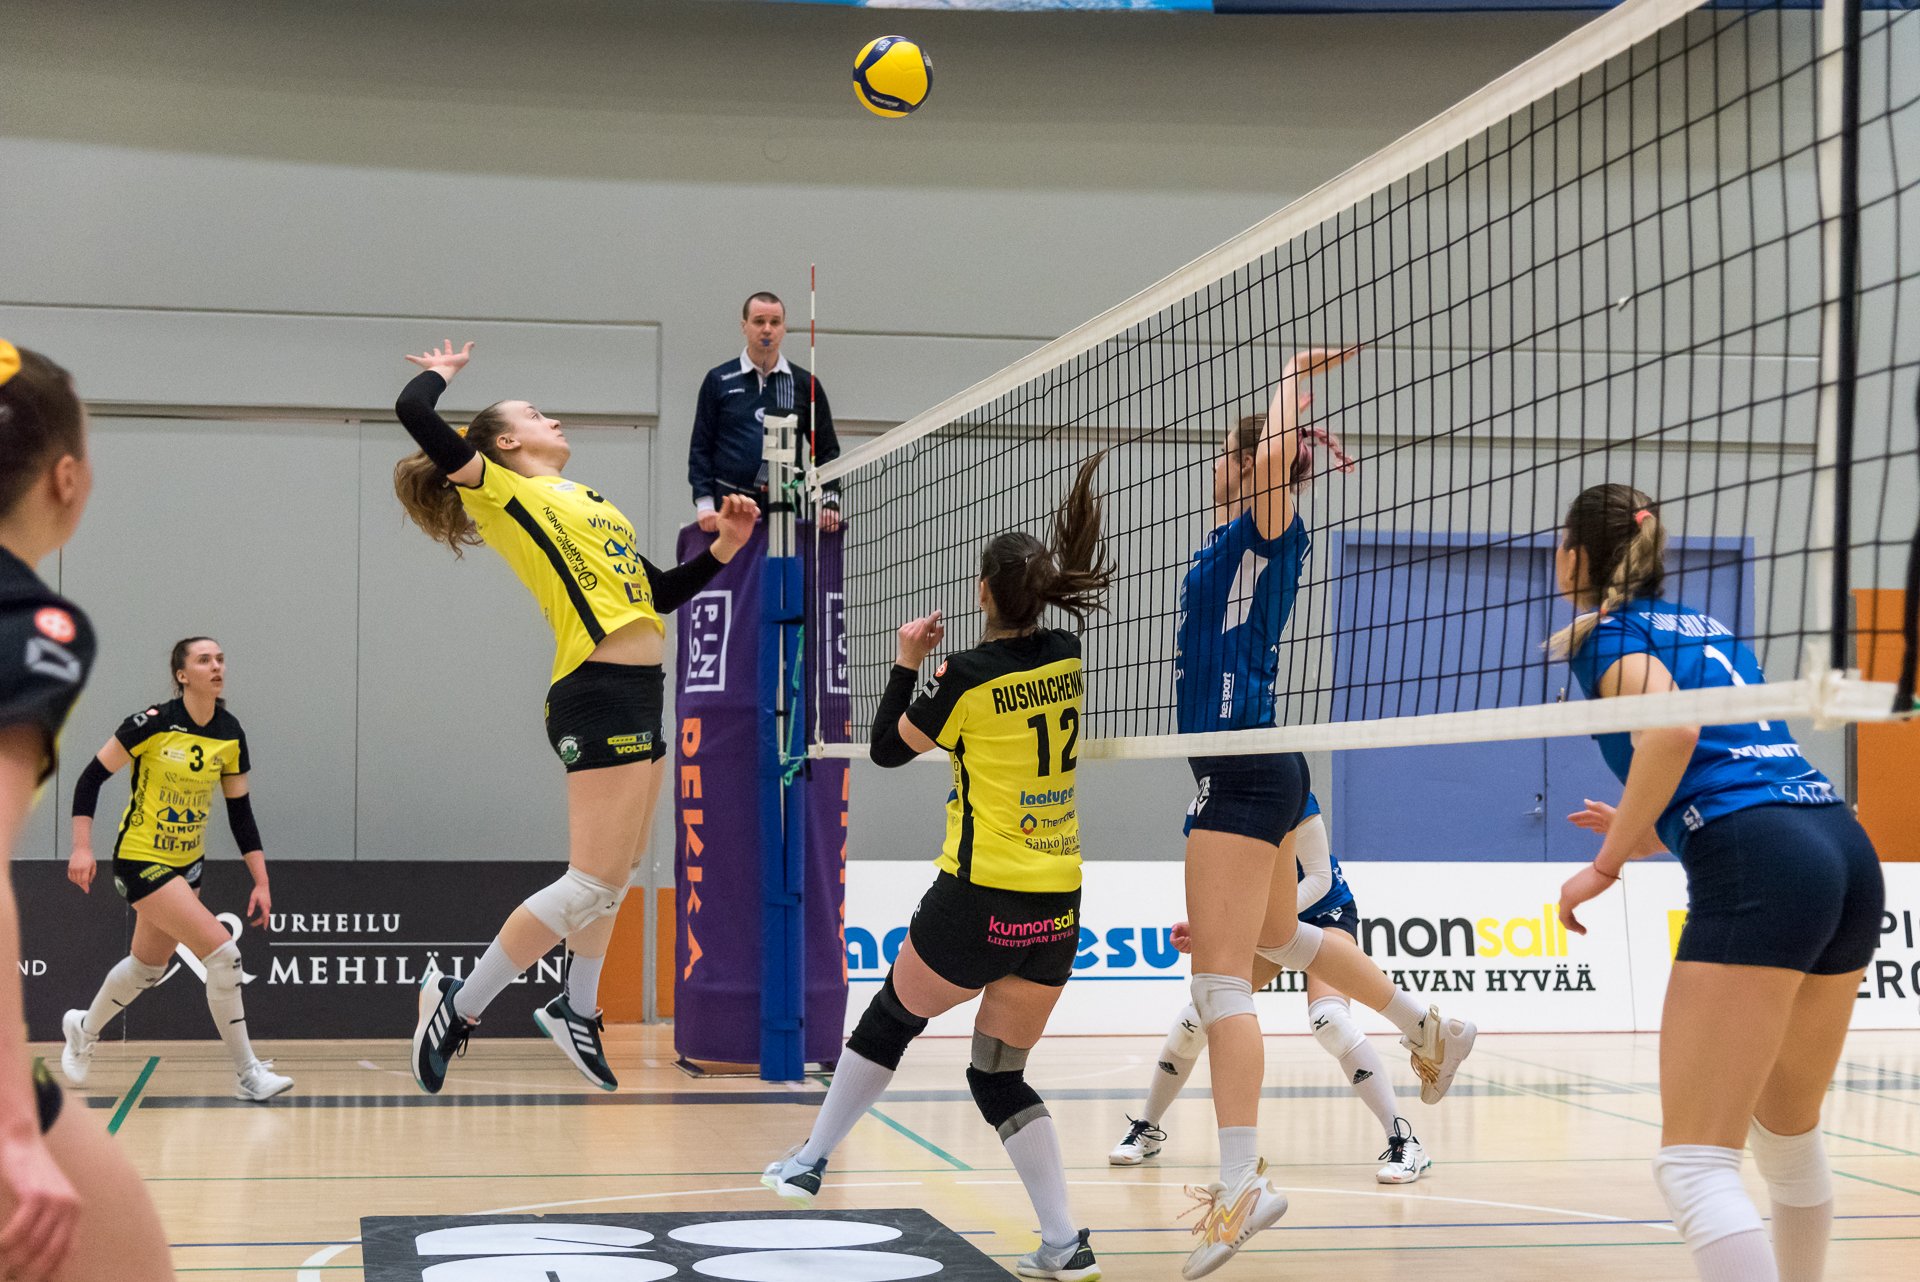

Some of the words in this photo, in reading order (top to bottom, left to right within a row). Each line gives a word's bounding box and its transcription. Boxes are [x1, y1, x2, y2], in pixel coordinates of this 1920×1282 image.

[1027, 706, 1079, 778] 12
[189, 745, 204, 772] 3
[1020, 785, 1076, 806] laatupe
[680, 717, 705, 982] PEKKA
[269, 913, 401, 934] URHEILU
[988, 908, 1075, 937] kunnonsali
[268, 951, 564, 985] MEHILÄIN
[1487, 963, 1596, 993] HYVÄÄ
